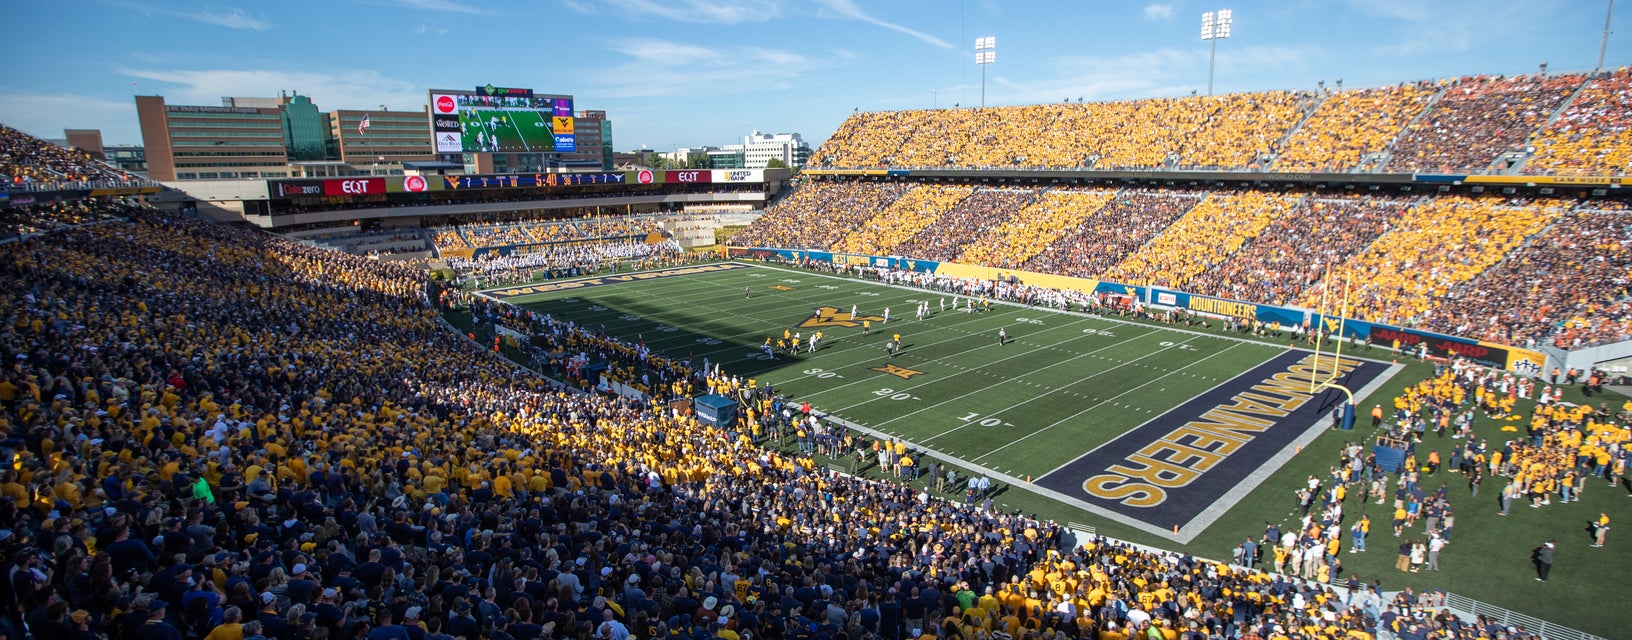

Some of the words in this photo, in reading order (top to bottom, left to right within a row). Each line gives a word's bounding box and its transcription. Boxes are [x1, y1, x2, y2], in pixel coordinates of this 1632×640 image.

[466, 177, 471, 188] 7
[535, 173, 558, 187] 5:40
[602, 173, 608, 184] 7
[678, 171, 699, 182] EQT
[341, 180, 369, 193] EQT
[491, 278, 605, 297] WEST
[1188, 295, 1257, 319] MOUNTAINEERS
[1374, 329, 1420, 345] AARP
[1436, 341, 1488, 357] AARP
[803, 368, 837, 379] 30
[871, 388, 912, 401] 20
[956, 411, 1002, 427] 10
[1082, 353, 1365, 508] MOUNTAINEERS
[737, 583, 748, 592] 67
[766, 578, 772, 588] 8
[1055, 583, 1061, 591] 8
[1142, 595, 1153, 604] 67
